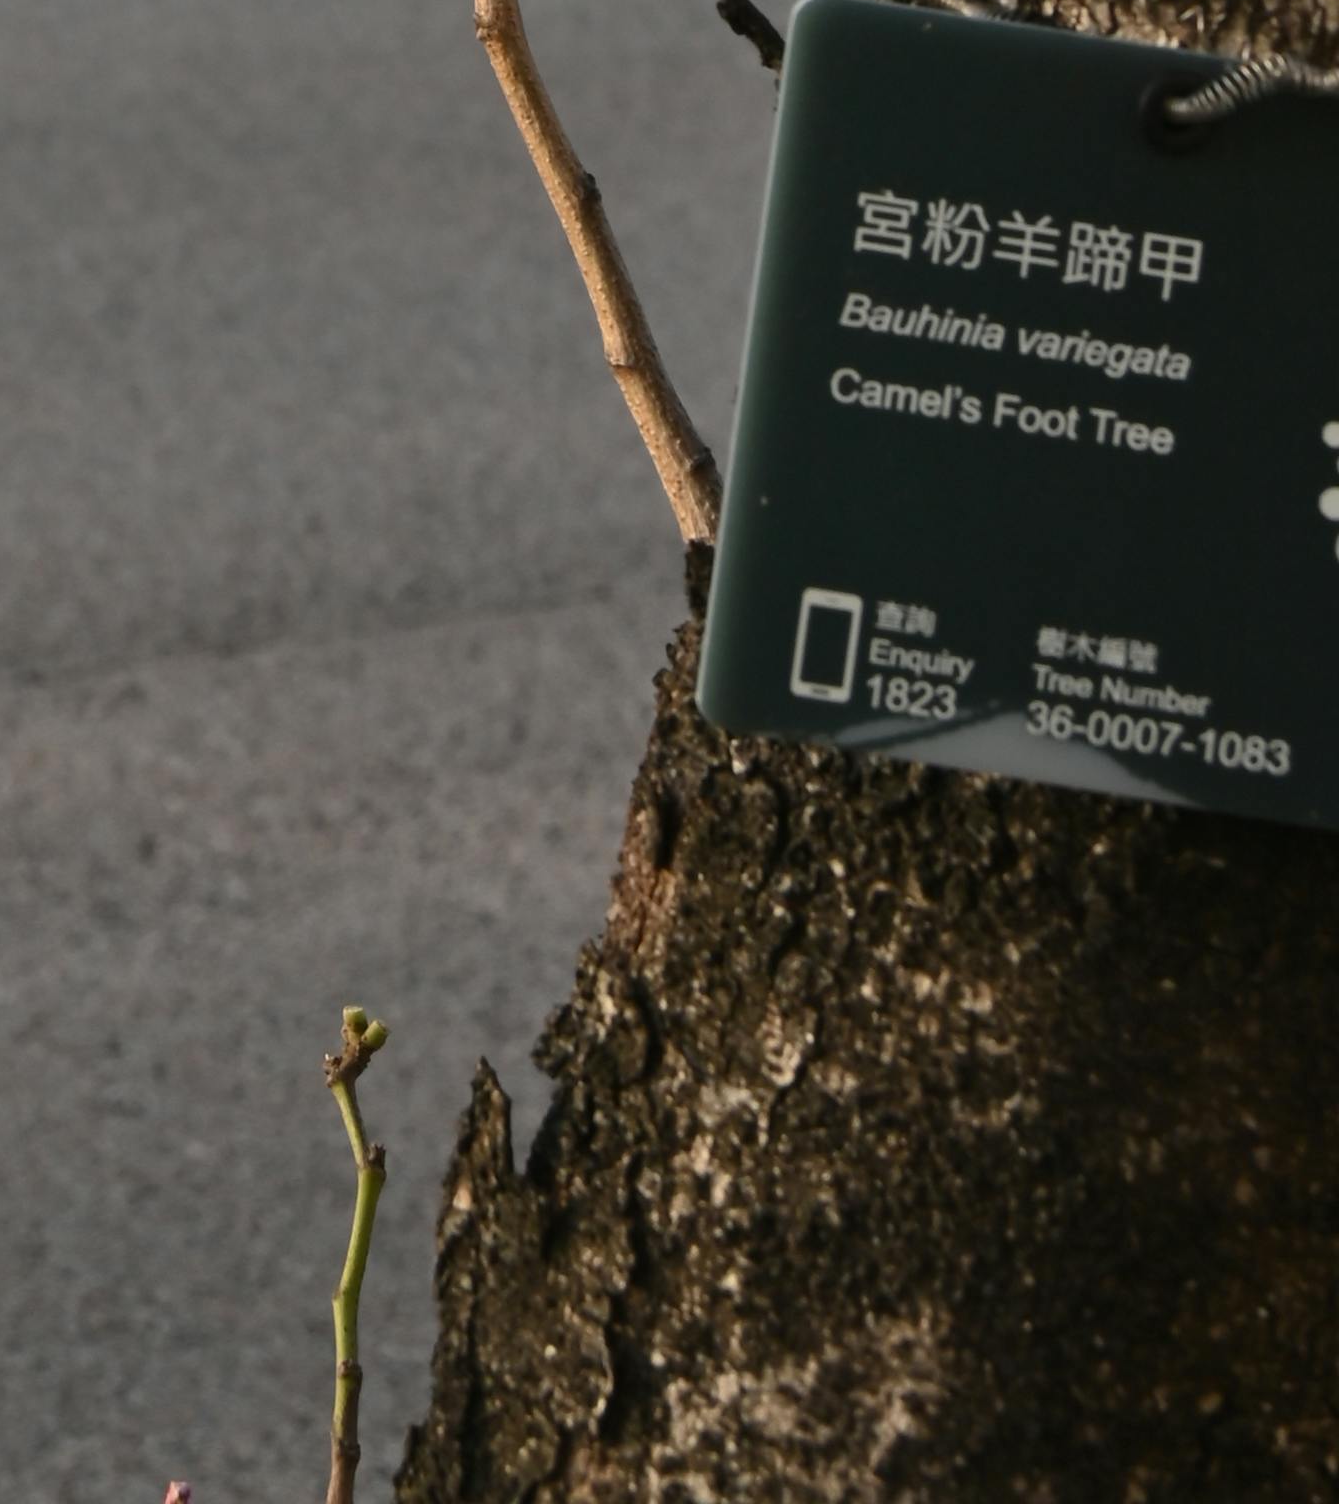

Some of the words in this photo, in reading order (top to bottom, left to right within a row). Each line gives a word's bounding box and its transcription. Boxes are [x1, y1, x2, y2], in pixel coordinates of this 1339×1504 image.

[854, 190, 1204, 302] 宮粉羊蹄甲
[839, 293, 1006, 350] Bauhinia
[1017, 327, 1192, 381] variegata
[830, 368, 983, 425] Camel's
[993, 393, 1080, 441] Foot
[1089, 408, 1175, 455] Tree
[866, 674, 957, 720] 1823
[869, 637, 975, 685] Enquiry
[1032, 663, 1094, 699] Tree
[1100, 674, 1211, 717] Number
[1026, 700, 1291, 775] 36-0007-1083
